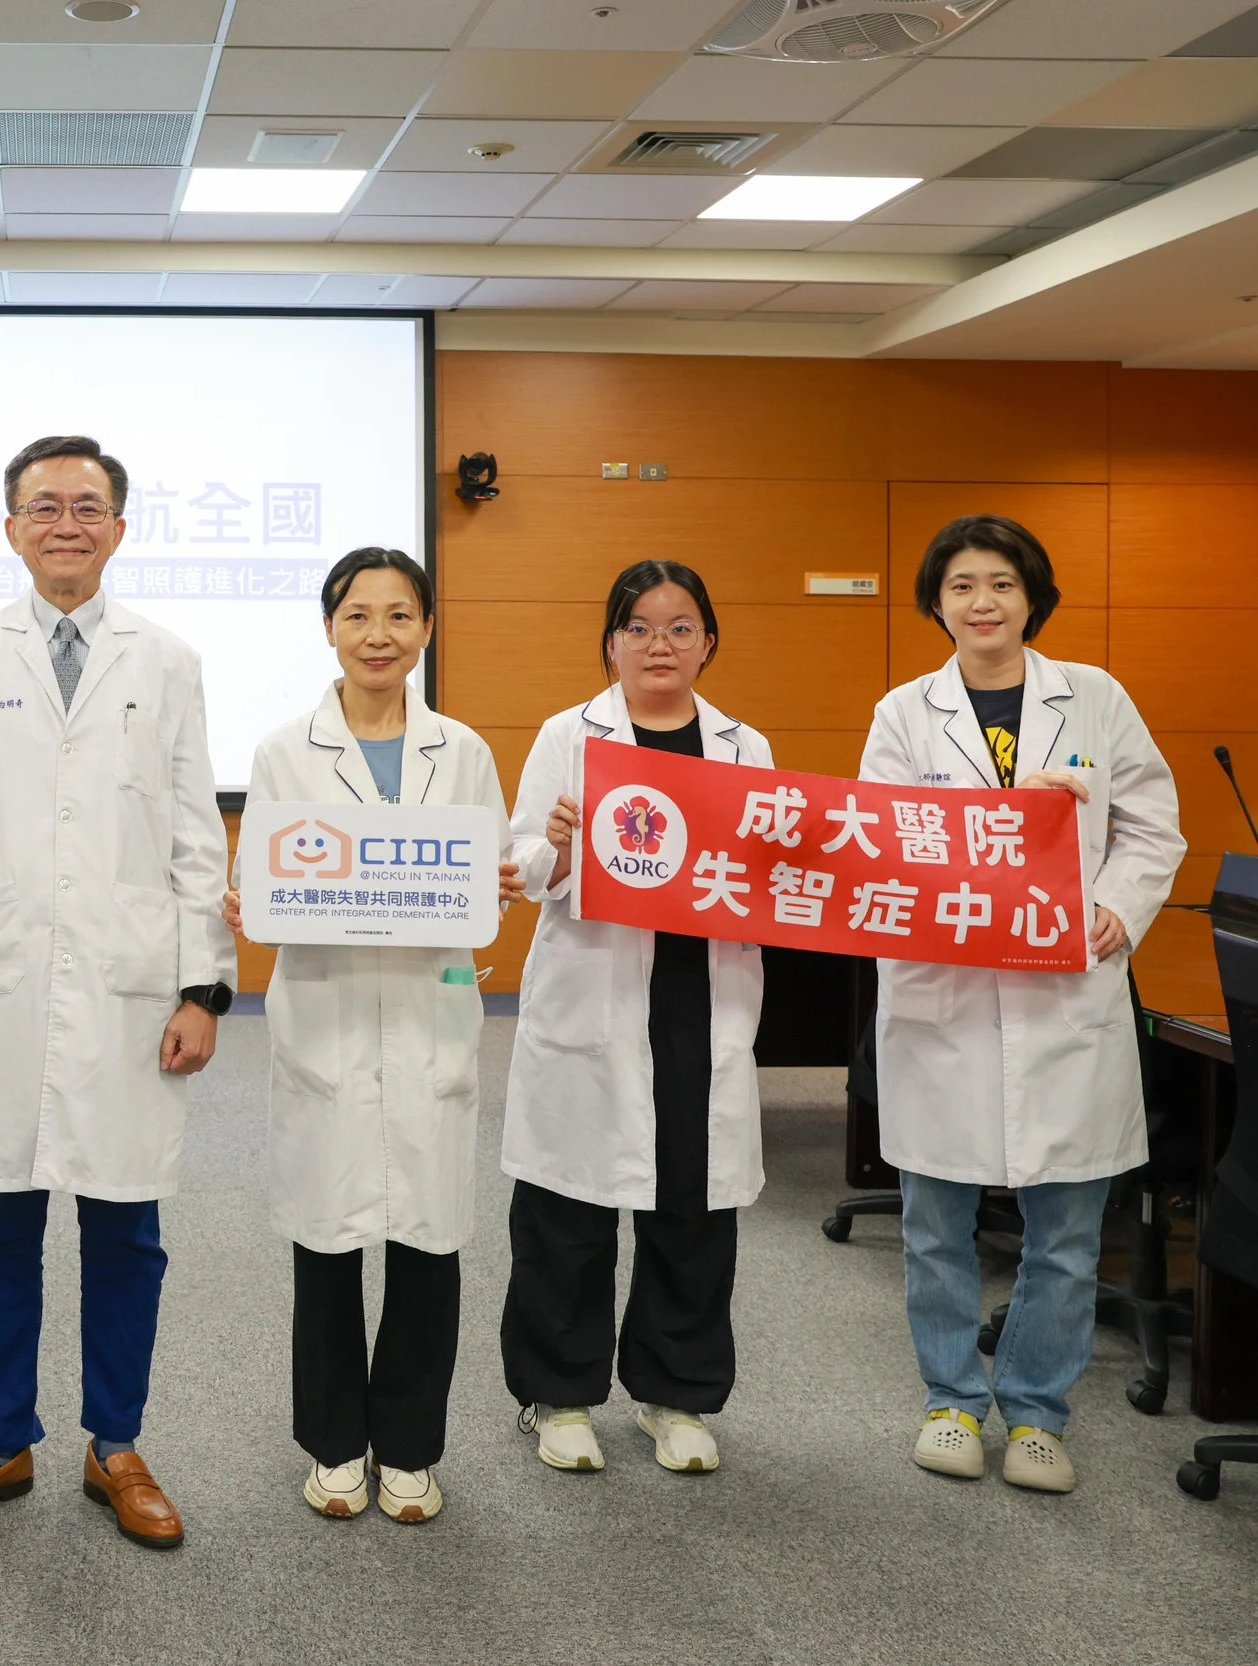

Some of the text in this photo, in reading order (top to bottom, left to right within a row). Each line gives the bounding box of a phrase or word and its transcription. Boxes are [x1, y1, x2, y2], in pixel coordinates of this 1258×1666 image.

[736, 786, 1026, 867] 成大醫院
[360, 838, 471, 867] CIDC
[410, 872, 422, 881] IN
[425, 872, 471, 882] TAINAN
[607, 855, 669, 879] ADRC
[270, 888, 470, 908] 成大醫院失智共同照護中心
[691, 850, 1070, 947] 失智症中心
[269, 908, 469, 920] CENTER FOR INTEGRATED DEMENTIA CARE
